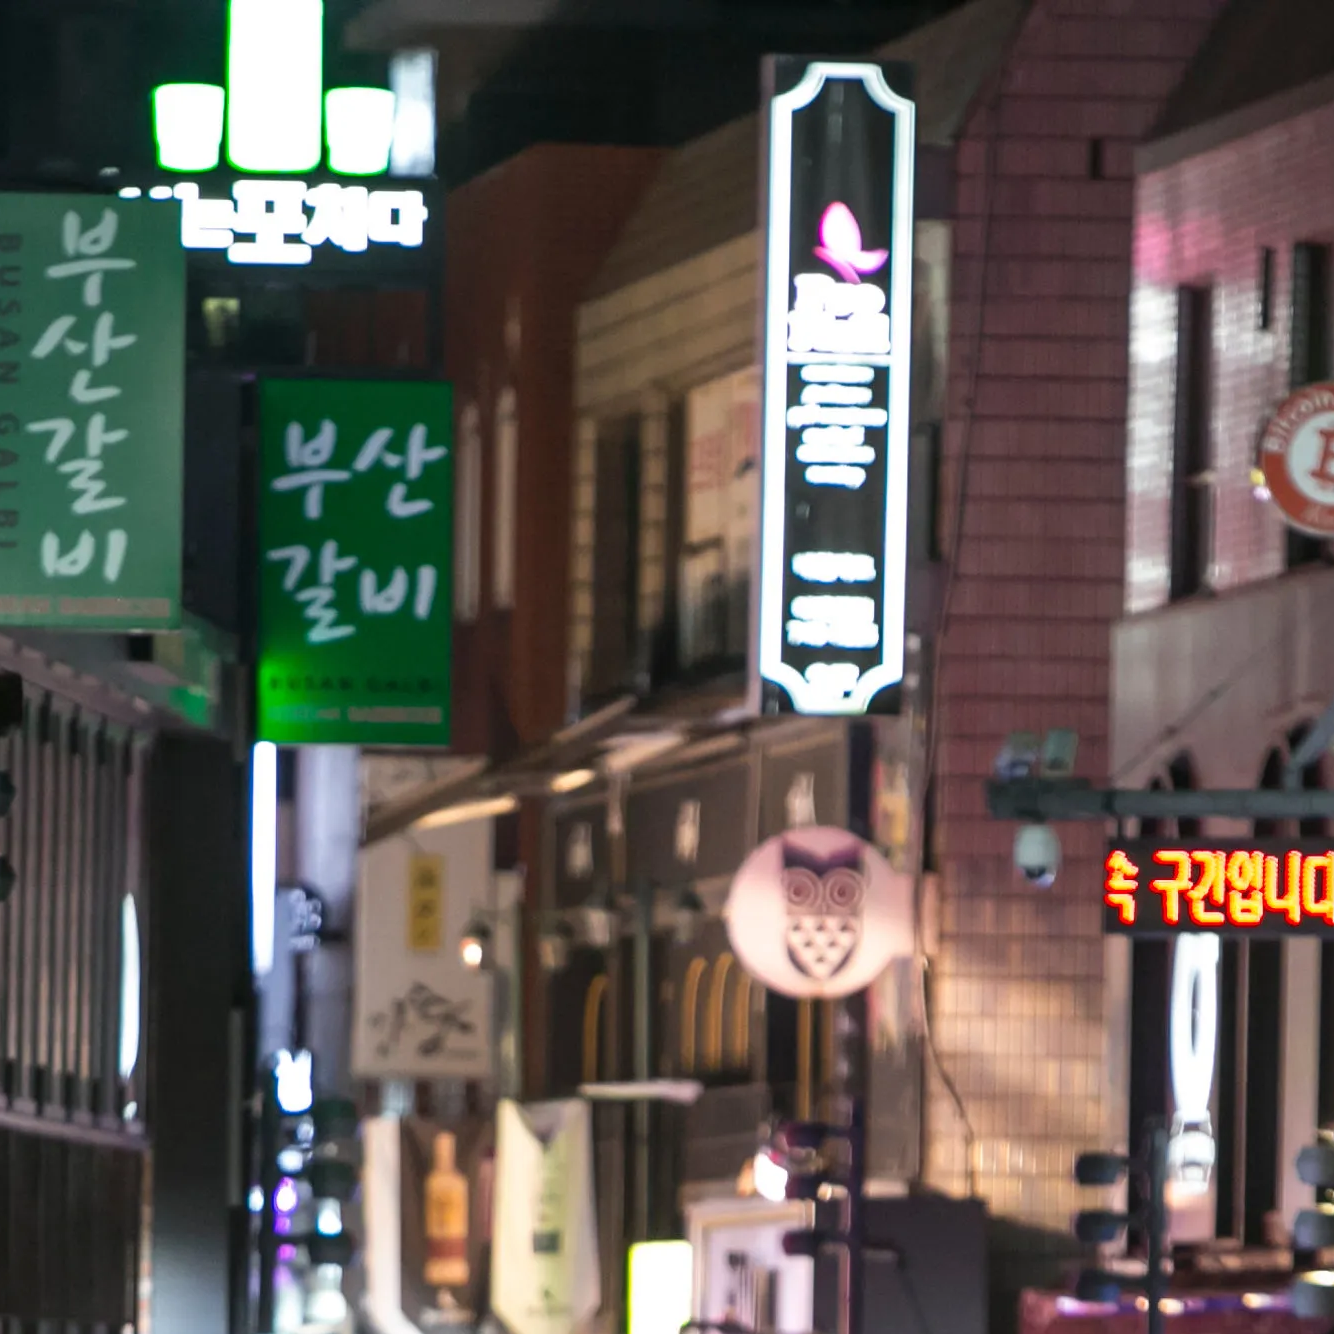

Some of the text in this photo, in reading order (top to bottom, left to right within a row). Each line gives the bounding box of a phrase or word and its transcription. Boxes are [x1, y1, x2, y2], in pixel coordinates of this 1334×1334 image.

[26, 207, 138, 583] 부산갈비
[271, 419, 449, 520] 부산
[267, 539, 437, 644] 갈비
[1104, 849, 1140, 925] 속
